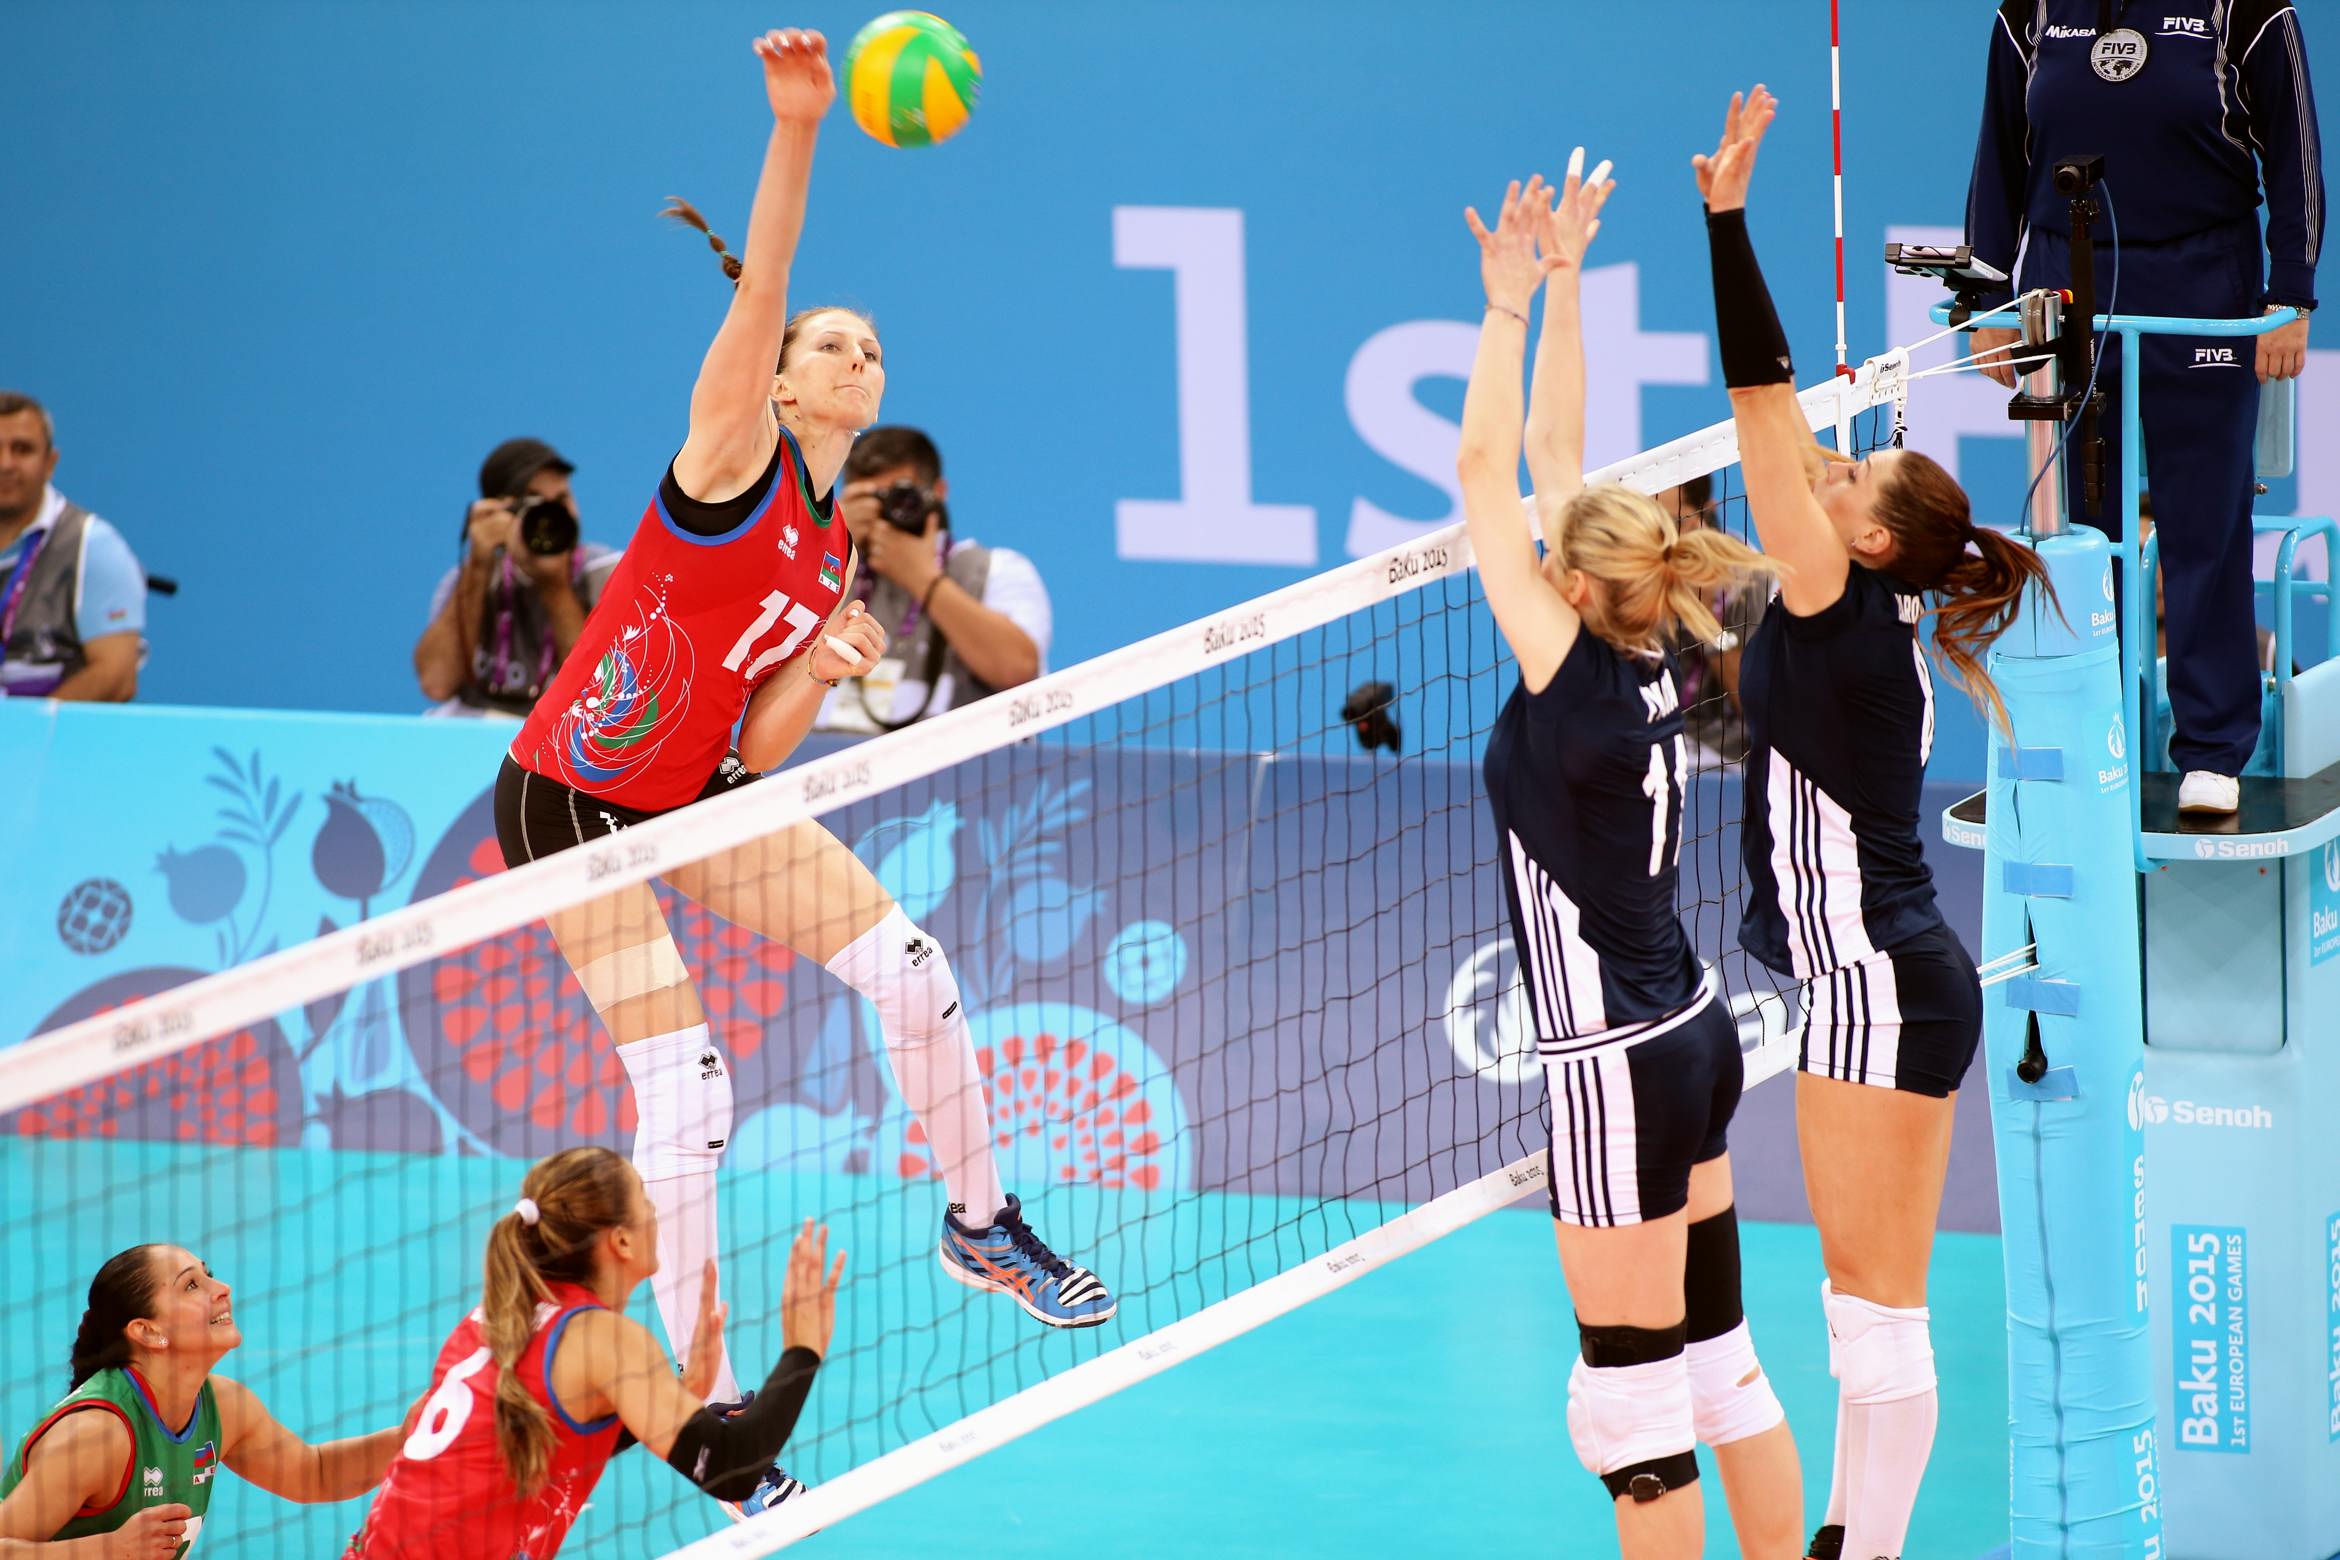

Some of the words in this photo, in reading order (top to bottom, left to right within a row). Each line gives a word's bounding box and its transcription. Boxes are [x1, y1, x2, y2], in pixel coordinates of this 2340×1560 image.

[2163, 17, 2205, 32] FIVB
[2101, 42, 2137, 55] FIVB
[2194, 348, 2236, 362] FIVB
[777, 538, 797, 561] errea
[721, 588, 820, 681] 17
[1950, 825, 1985, 846] Sen
[2217, 837, 2289, 858] Senoh
[2313, 903, 2338, 939] Baku
[911, 946, 933, 967] errea
[701, 1068, 723, 1080] errea
[2172, 1099, 2273, 1129] Senoh
[2187, 1232, 2221, 1326] 2015
[2226, 1233, 2243, 1302] GAMES
[2228, 1305, 2246, 1412] EUROPEAN
[402, 1345, 491, 1461] 6
[2178, 1339, 2219, 1445] Baku
[194, 1466, 216, 1483] AE
[2132, 1429, 2159, 1524] 2015
[143, 1486, 164, 1497] rrea
